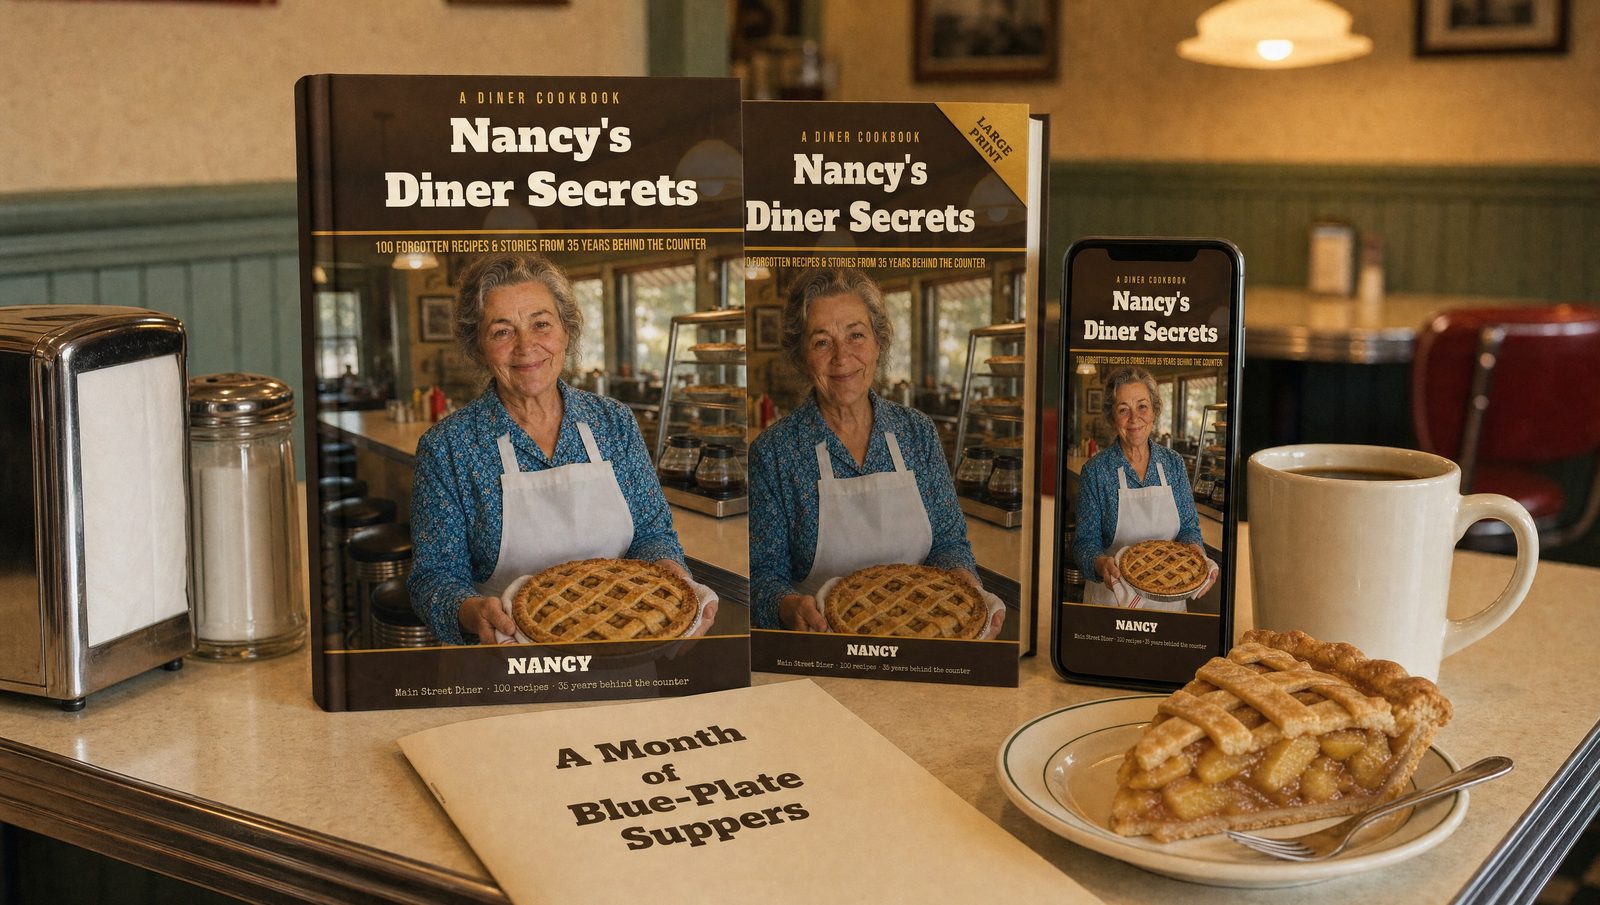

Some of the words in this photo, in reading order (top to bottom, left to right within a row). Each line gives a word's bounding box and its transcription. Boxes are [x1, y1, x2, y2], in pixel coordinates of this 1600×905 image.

[459, 91, 467, 105] A
[478, 91, 526, 105] DINER
[536, 91, 620, 105] COOKBOOK
[450, 117, 631, 162] Nancy's
[801, 131, 807, 143] A
[815, 131, 851, 143] DINER
[858, 131, 921, 143] COOKBOOK
[969, 127, 1003, 163] PRINT
[976, 115, 1013, 157] LARGE
[793, 153, 928, 193] Nancy's
[385, 172, 515, 208] Diner
[527, 171, 699, 207] Secrets
[746, 200, 840, 232] Diner
[849, 200, 975, 233] Secrets
[375, 240, 393, 254] 100
[396, 240, 449, 253] FORGOTTEN
[451, 240, 489, 253] RECIPES
[491, 239, 498, 252] &
[500, 239, 537, 252] STORIES
[539, 239, 564, 252] FROM
[567, 239, 579, 251] 35
[581, 239, 609, 251] YEARS
[612, 238, 645, 251] BEHIND
[647, 238, 664, 250] THE
[666, 238, 707, 250] COUNTER
[752, 257, 790, 268] FORGOTTEN
[792, 257, 820, 268] RECIPES
[821, 257, 827, 268] &
[828, 257, 856, 268] STORIES
[857, 257, 876, 268] FROM
[878, 257, 887, 268] 35
[888, 257, 911, 268] YEARS
[912, 258, 938, 269] BEHIND
[939, 258, 953, 269] THE
[954, 258, 986, 269] COUNTER
[1116, 275, 1120, 284] A
[1124, 275, 1145, 284] DINER
[1148, 276, 1186, 285] COOKBOOK
[1112, 290, 1190, 317] Nancy's
[1083, 319, 1139, 341] Diner
[1144, 320, 1218, 343] Secrets
[1115, 619, 1158, 632] NANCY
[846, 643, 899, 658] NANCY
[507, 654, 593, 676] NANCY
[777, 659, 793, 667] Main
[793, 660, 815, 668] Street
[816, 661, 834, 669] Diner
[852, 663, 877, 671] recipes
[890, 665, 909, 673] years
[910, 665, 932, 673] behind
[933, 666, 944, 674] the
[945, 667, 972, 675] counter
[395, 687, 419, 698] Main
[421, 686, 453, 697] Street
[455, 685, 483, 696] Diner
[493, 683, 511, 694] 100
[513, 682, 549, 695] recipes
[558, 681, 570, 692] 35
[571, 682, 598, 693] years
[599, 679, 633, 690] behind
[635, 678, 651, 689] the
[652, 677, 690, 688] counter
[556, 747, 592, 770] A
[594, 725, 747, 763] Month
[641, 763, 681, 785] of
[567, 772, 805, 826] Blue-Plate
[620, 802, 810, 851] Suppers
